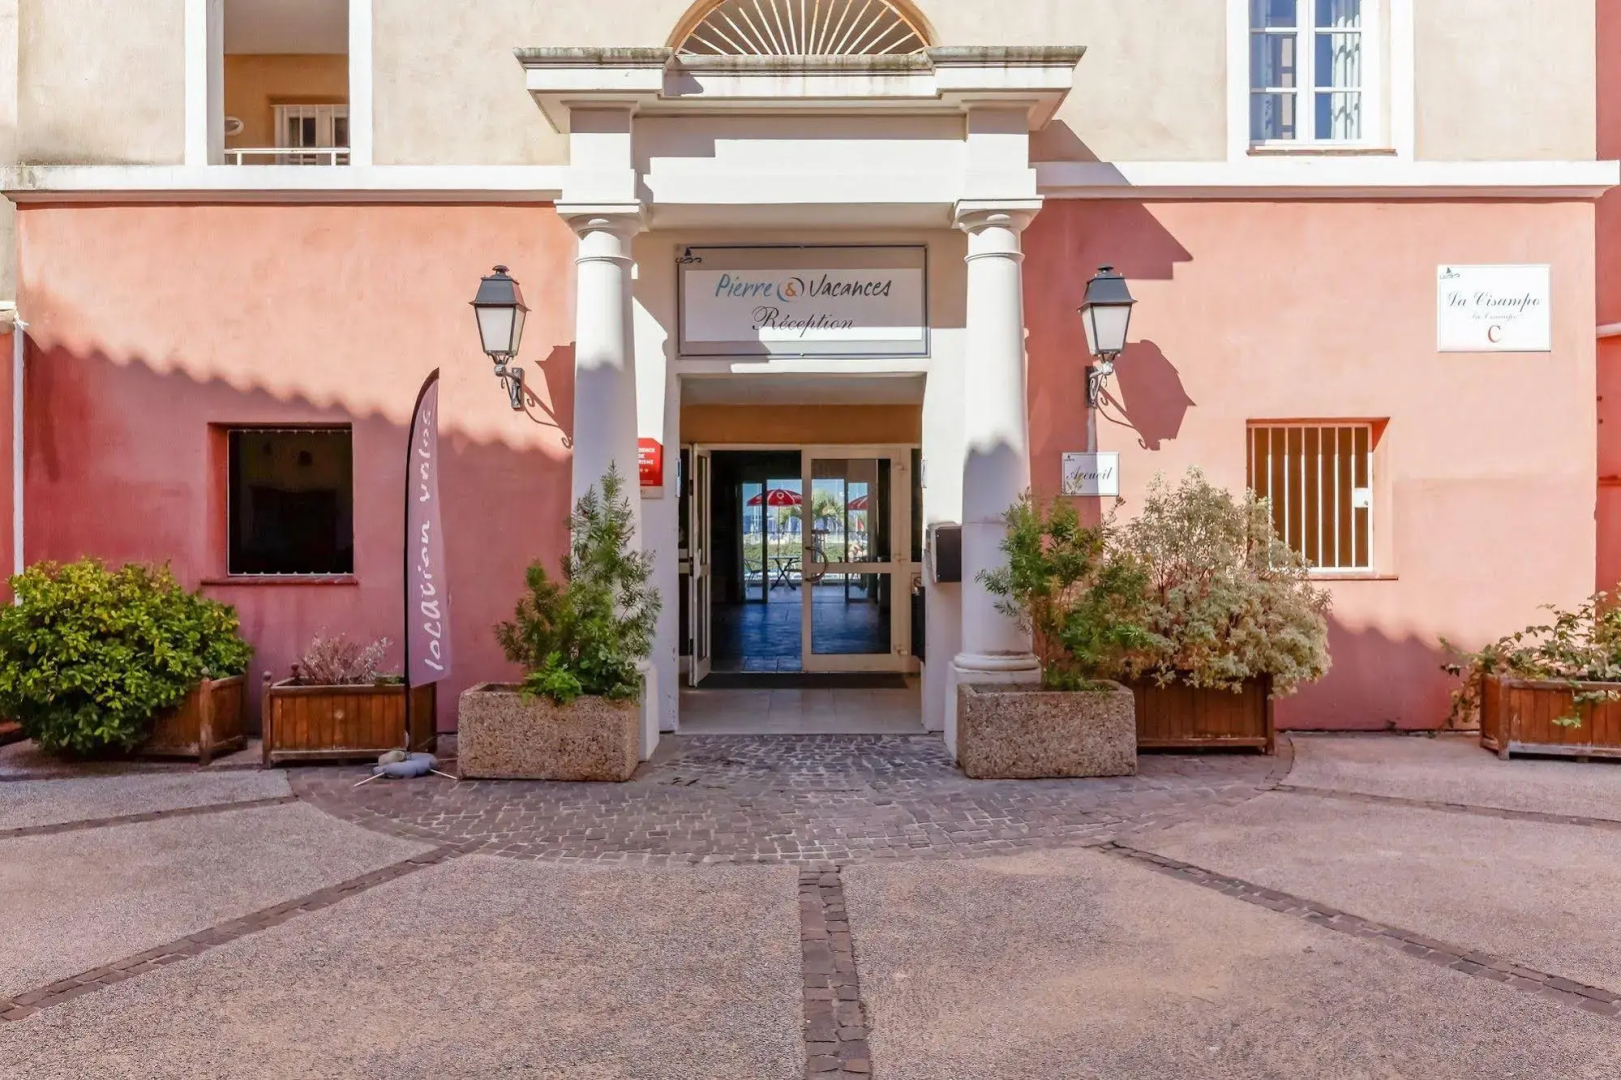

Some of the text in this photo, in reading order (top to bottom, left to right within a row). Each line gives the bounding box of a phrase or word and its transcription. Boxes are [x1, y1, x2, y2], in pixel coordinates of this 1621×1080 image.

[715, 273, 774, 298] Pierre
[808, 273, 892, 297] Vacances
[1448, 290, 1541, 313] La Cisampo
[752, 305, 856, 338] Réception
[1487, 324, 1501, 343] C
